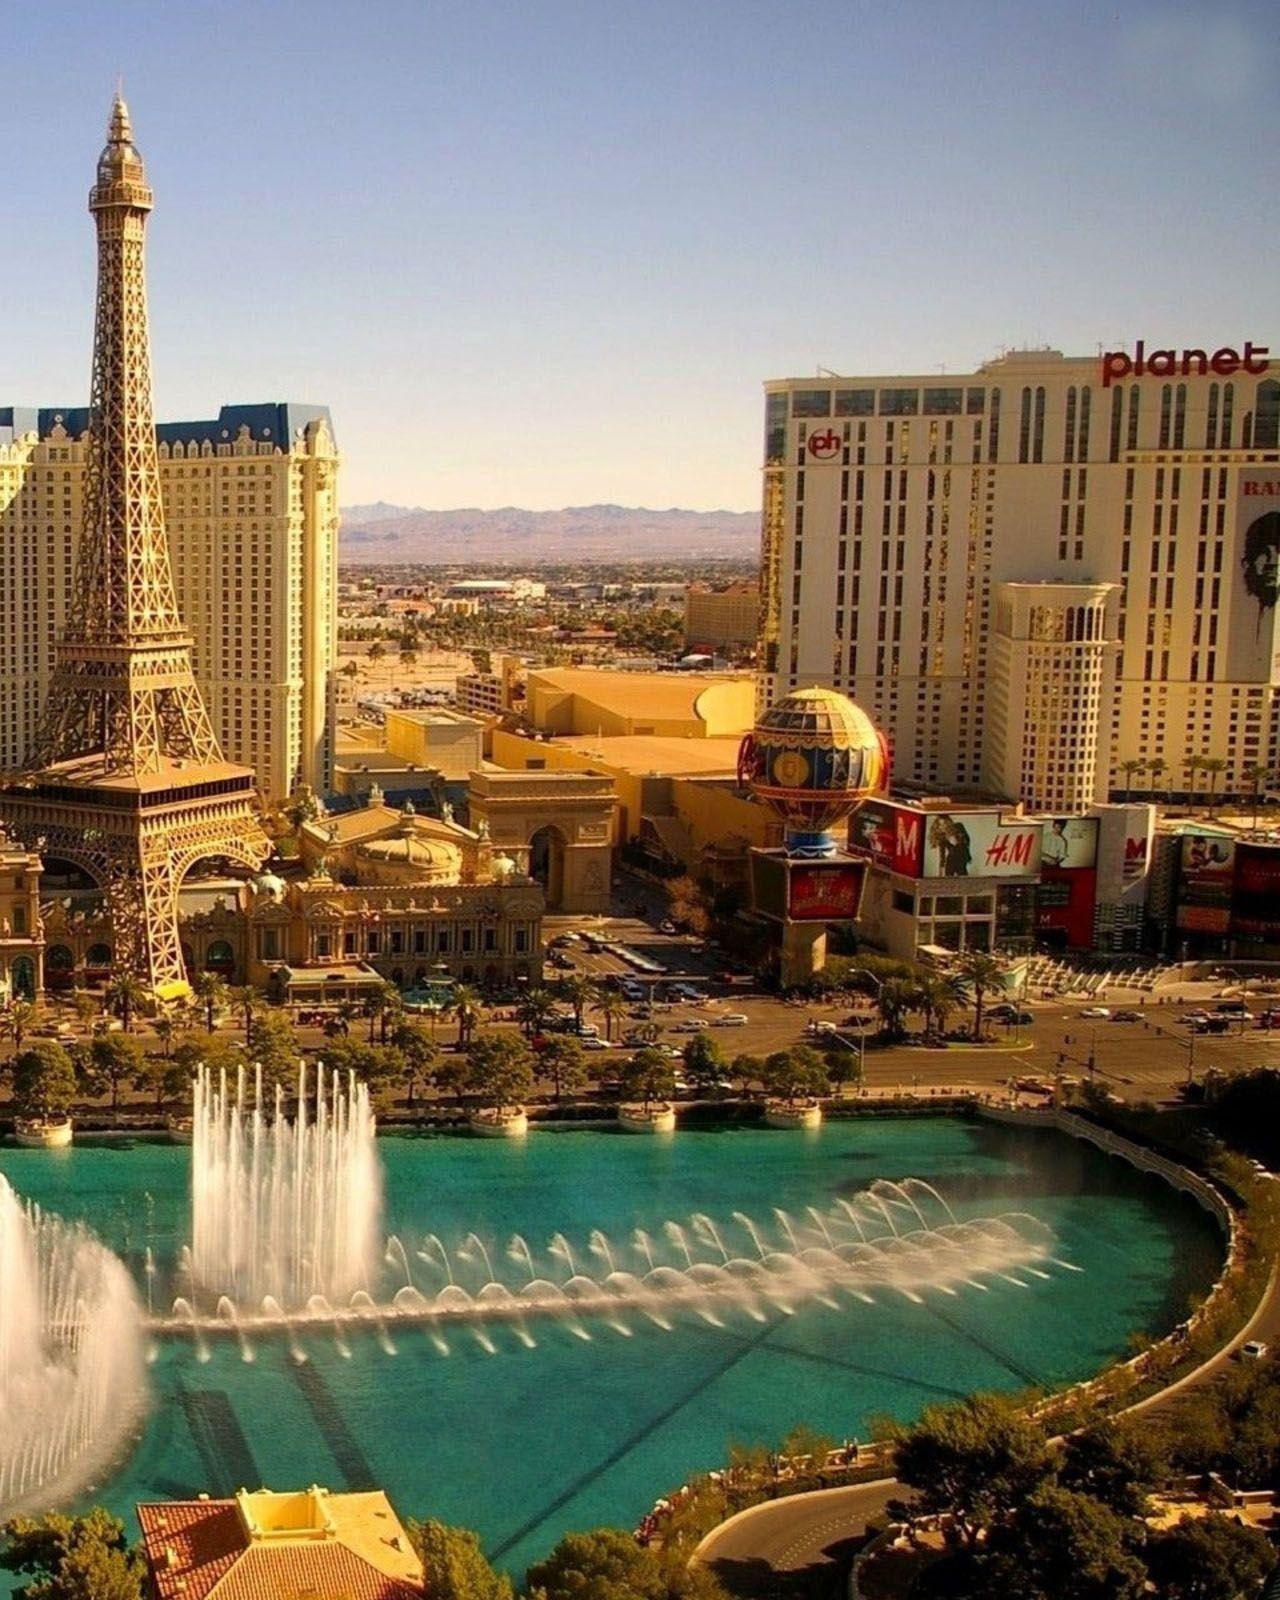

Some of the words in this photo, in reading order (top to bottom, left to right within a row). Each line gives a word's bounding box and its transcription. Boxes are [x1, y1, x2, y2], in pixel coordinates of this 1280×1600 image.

[1102, 340, 1270, 388] planet
[811, 428, 840, 455] ph
[984, 833, 1035, 867] H&M
